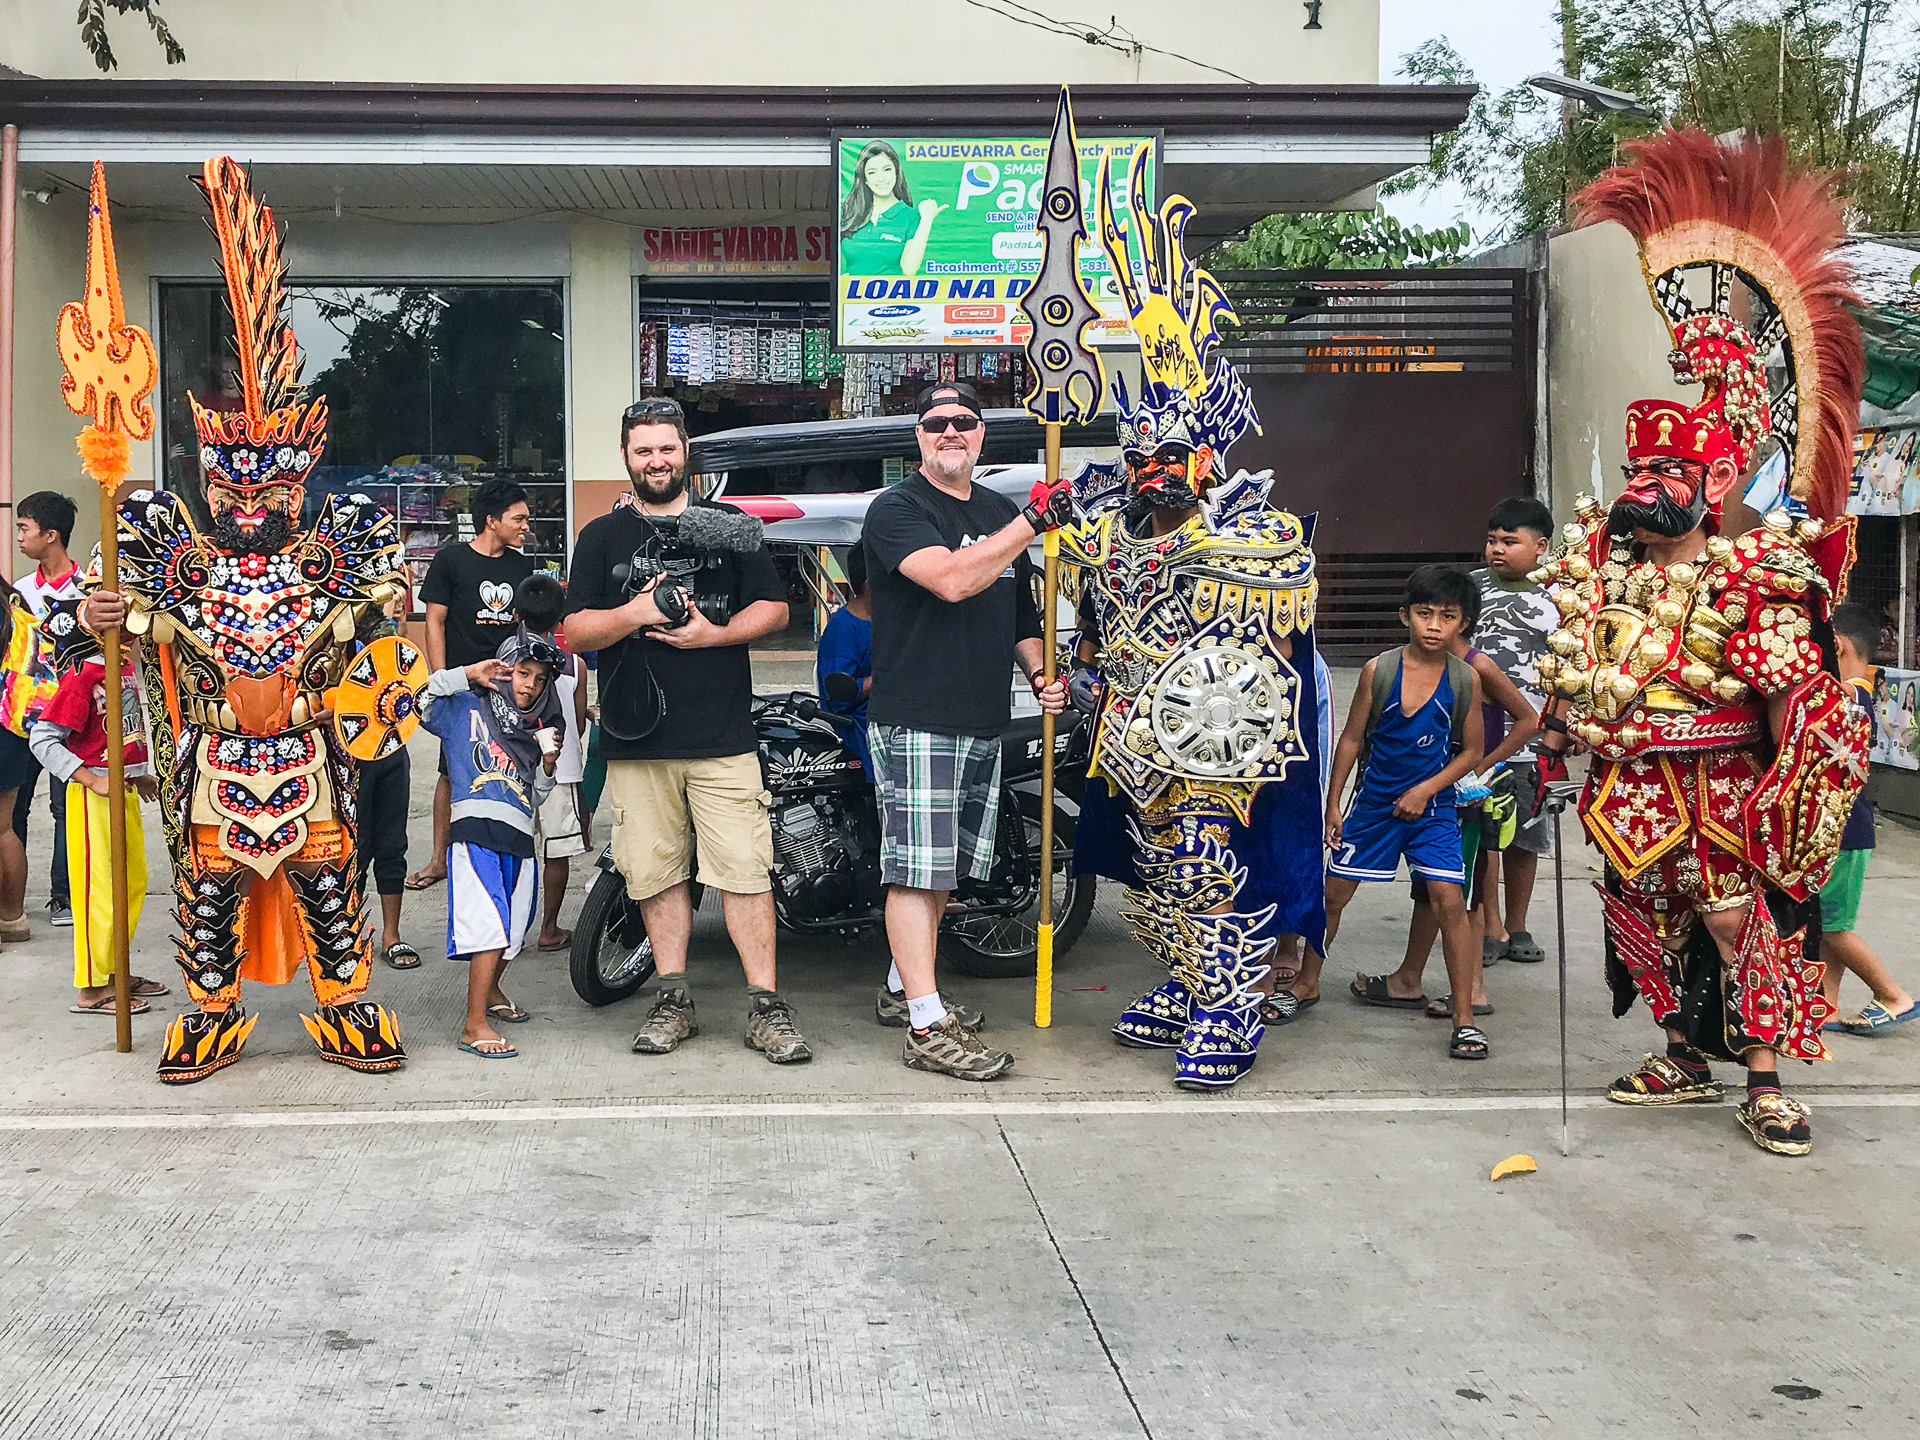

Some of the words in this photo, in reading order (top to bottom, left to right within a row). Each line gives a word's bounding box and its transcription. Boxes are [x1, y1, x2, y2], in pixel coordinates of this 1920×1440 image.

[908, 145, 1016, 158] SAGUEVARRA
[1003, 163, 1044, 175] SMAR
[986, 212, 1015, 222] SEND
[1017, 212, 1024, 221] &
[643, 225, 799, 263] SAGUEVARRA
[805, 226, 831, 262] ST
[926, 262, 1003, 273] Encashment
[1008, 262, 1017, 272] #
[846, 278, 939, 300] LOAD
[947, 279, 996, 300] NA
[873, 307, 914, 315] Buddy
[848, 318, 926, 326] Load
[1026, 732, 1071, 754] 15
[782, 761, 847, 775] BARAKO
[1339, 841, 1356, 865] 7
